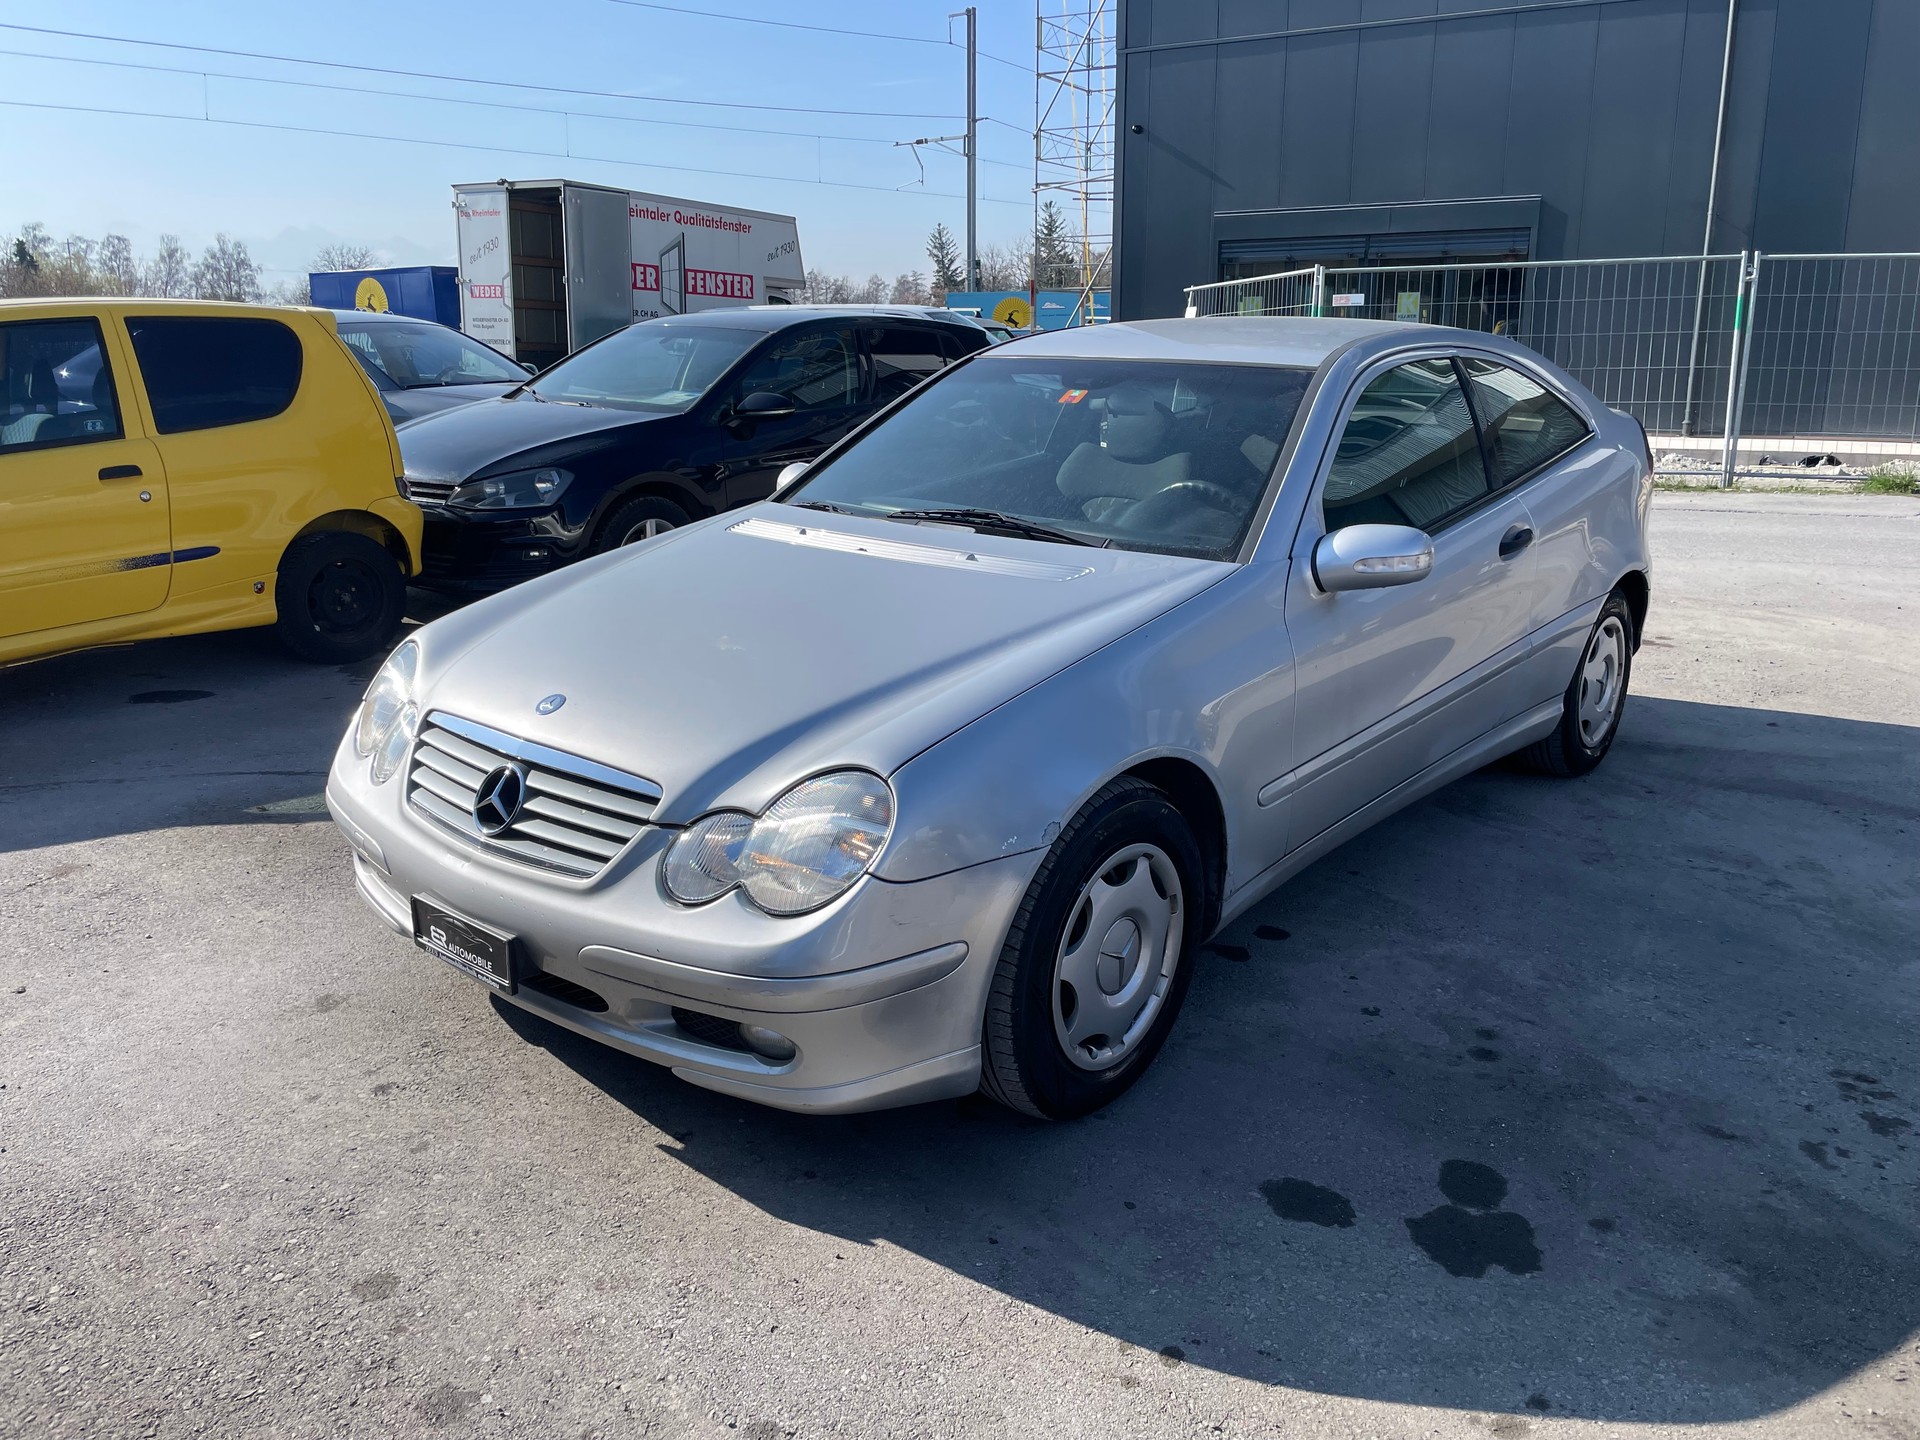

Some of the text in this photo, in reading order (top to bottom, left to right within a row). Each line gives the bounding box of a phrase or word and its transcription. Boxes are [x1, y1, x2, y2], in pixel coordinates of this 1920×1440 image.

[471, 209, 501, 217] Rheintaler
[629, 204, 753, 234] eintaler Qualitätsfenster
[469, 236, 499, 265] seit 1930
[767, 240, 795, 262] seit 1930
[471, 286, 502, 298] WEDER
[632, 265, 753, 298] ER FENSTER
[650, 310, 659, 319] AG
[448, 942, 494, 972] AUTOMOBILE
